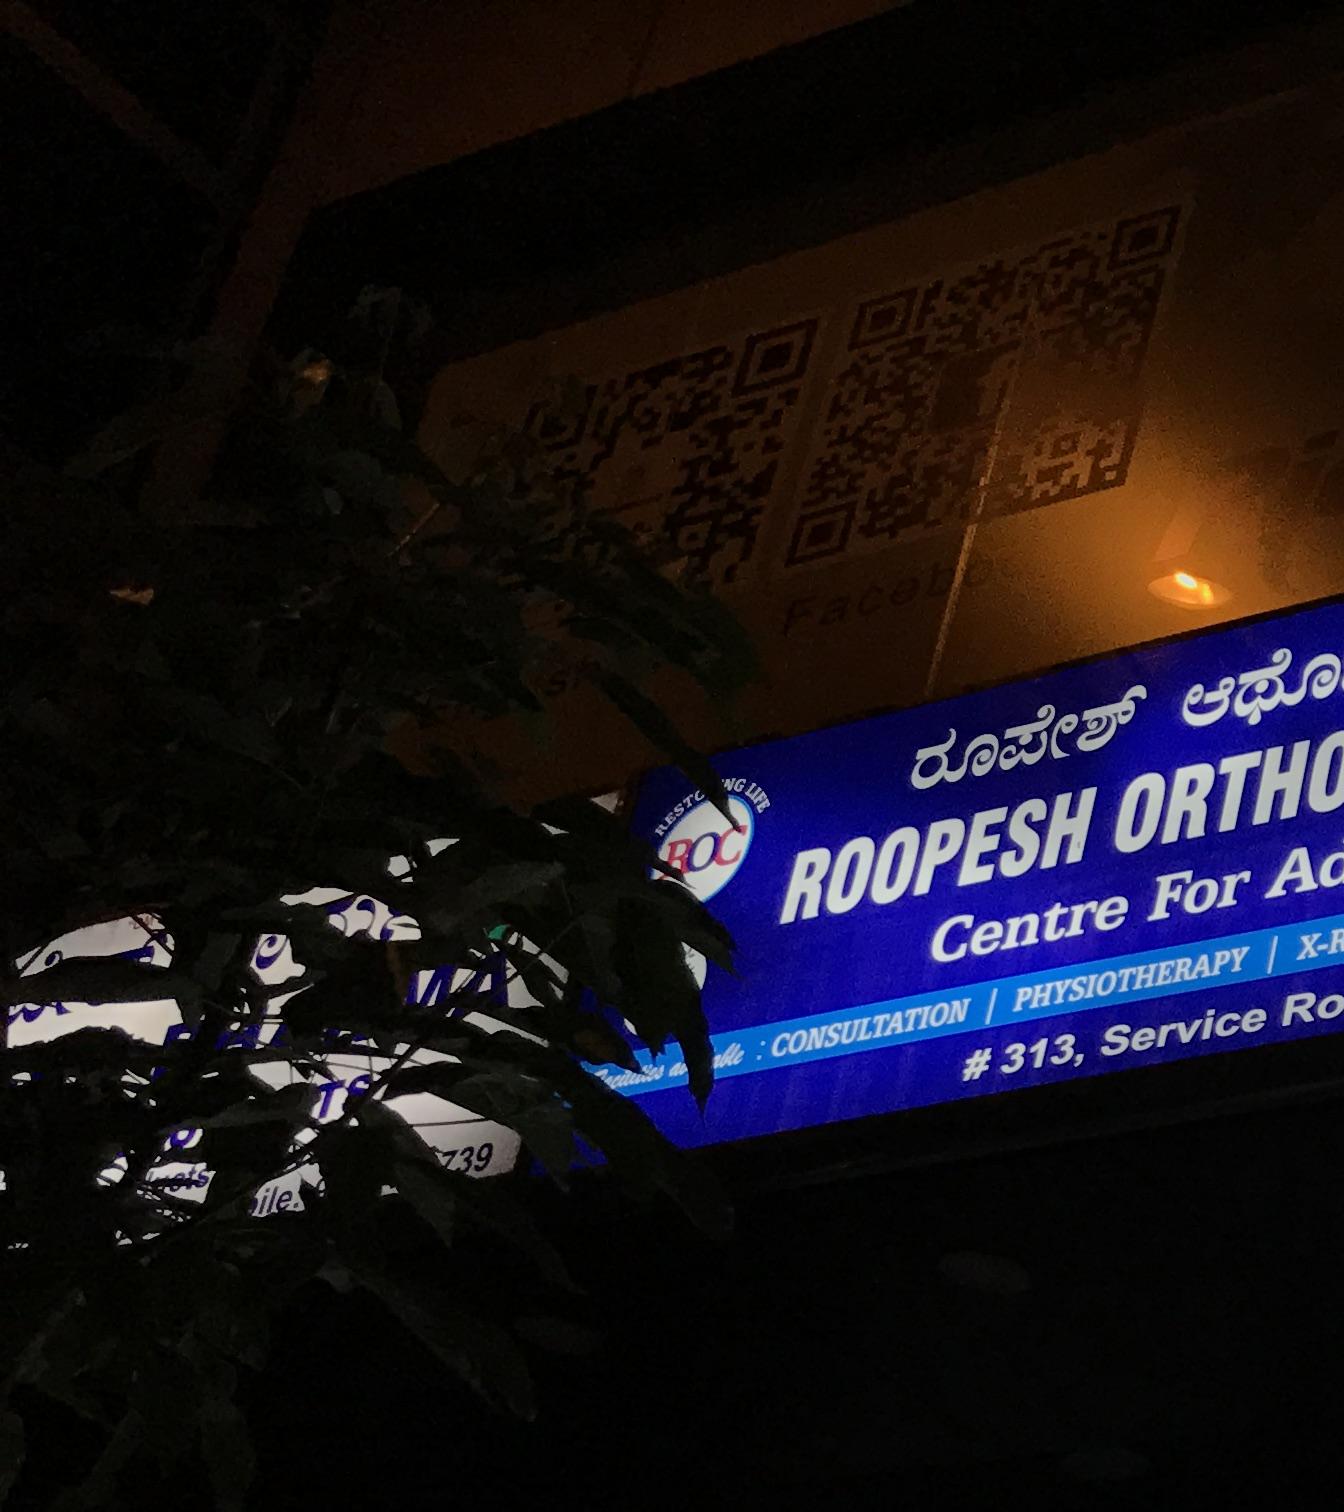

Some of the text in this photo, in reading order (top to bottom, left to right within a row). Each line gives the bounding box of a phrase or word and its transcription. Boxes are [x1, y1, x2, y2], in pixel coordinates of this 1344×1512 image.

[910, 684, 1147, 790] ರೂಪೇಶ್
[744, 782, 771, 814] LIFE
[656, 824, 748, 878] ROC
[779, 786, 1098, 925] ROOPESH
[930, 896, 1129, 963] Centre
[1146, 869, 1252, 922] For
[771, 998, 972, 1057] CONSULTATION
[1012, 946, 1250, 1012] PHYSIOTHERAPY
[1000, 1033, 1085, 1074] 313,
[1100, 1008, 1267, 1056] Service
